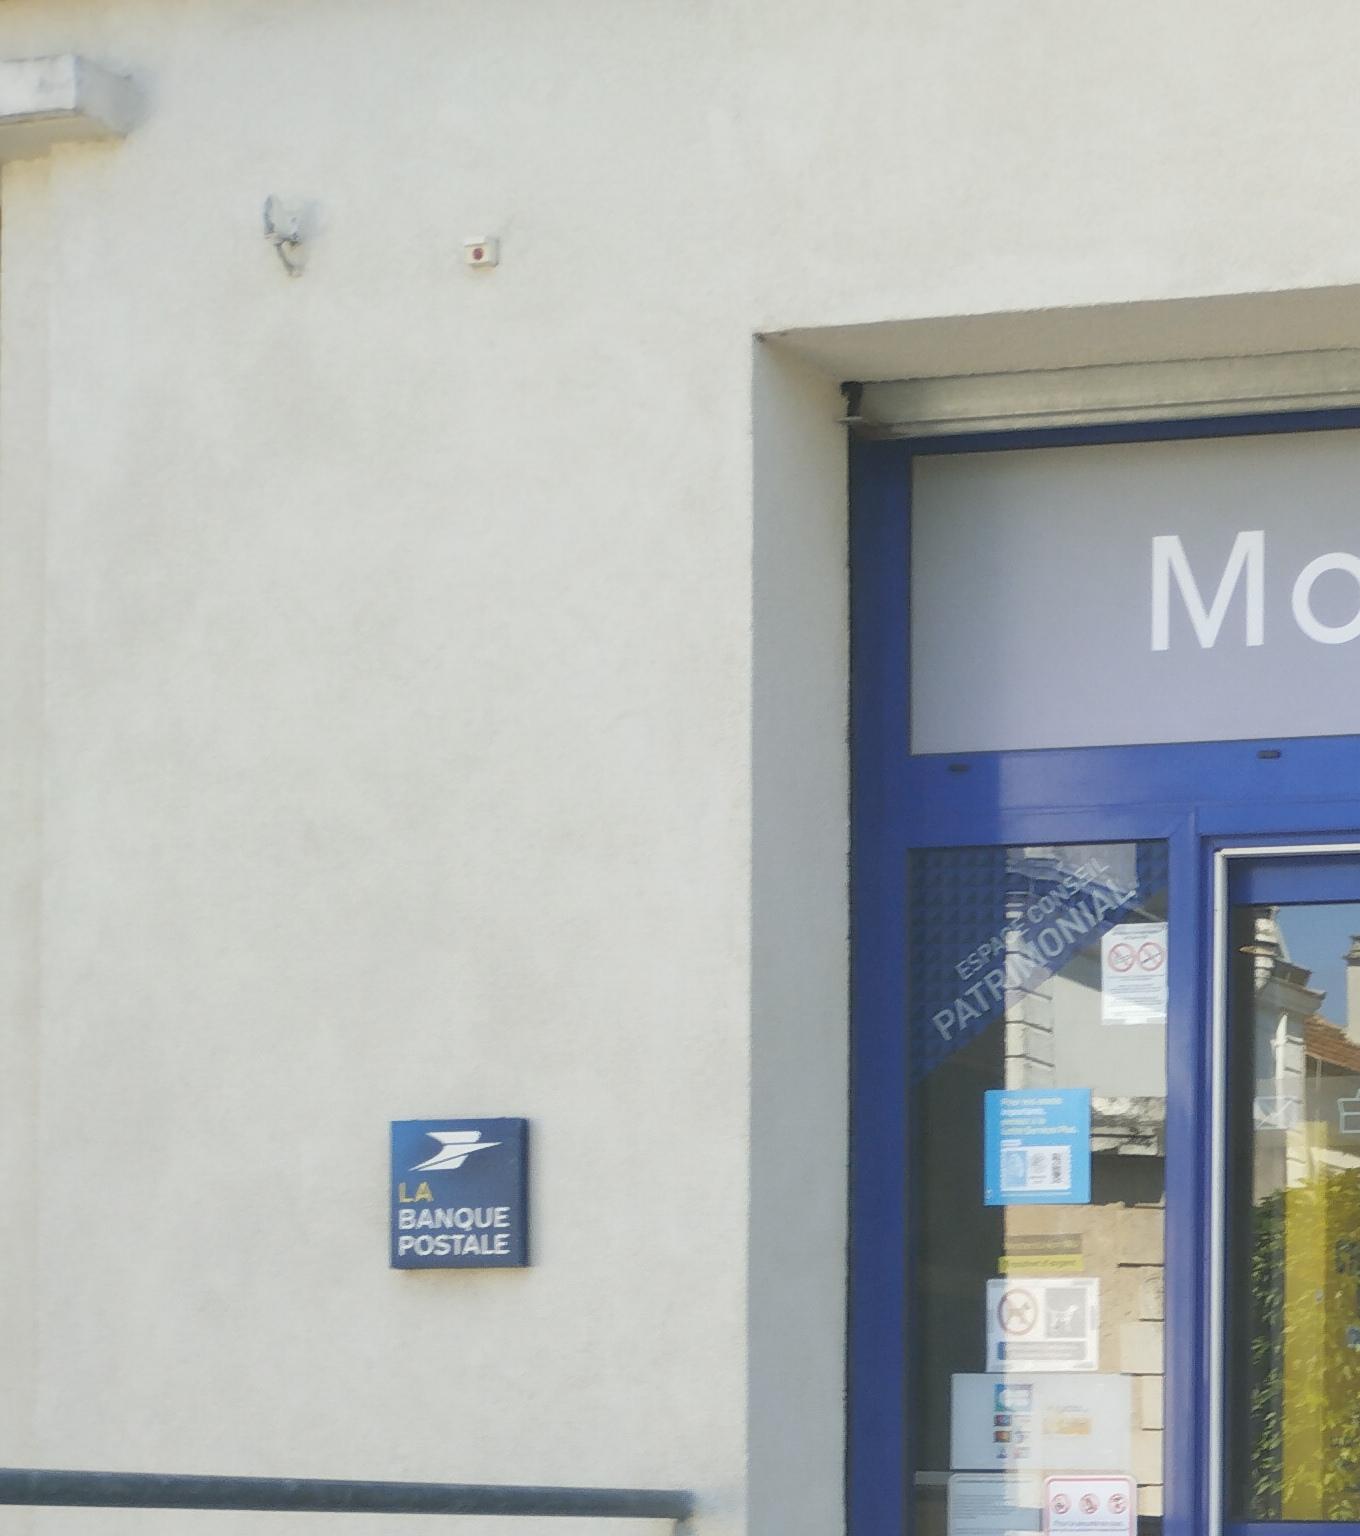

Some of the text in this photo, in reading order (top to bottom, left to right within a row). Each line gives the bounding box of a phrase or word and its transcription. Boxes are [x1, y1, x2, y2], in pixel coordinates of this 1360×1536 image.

[399, 1181, 434, 1203] LA
[398, 1206, 511, 1231] BANQUE
[398, 1233, 511, 1256] POSTALE
